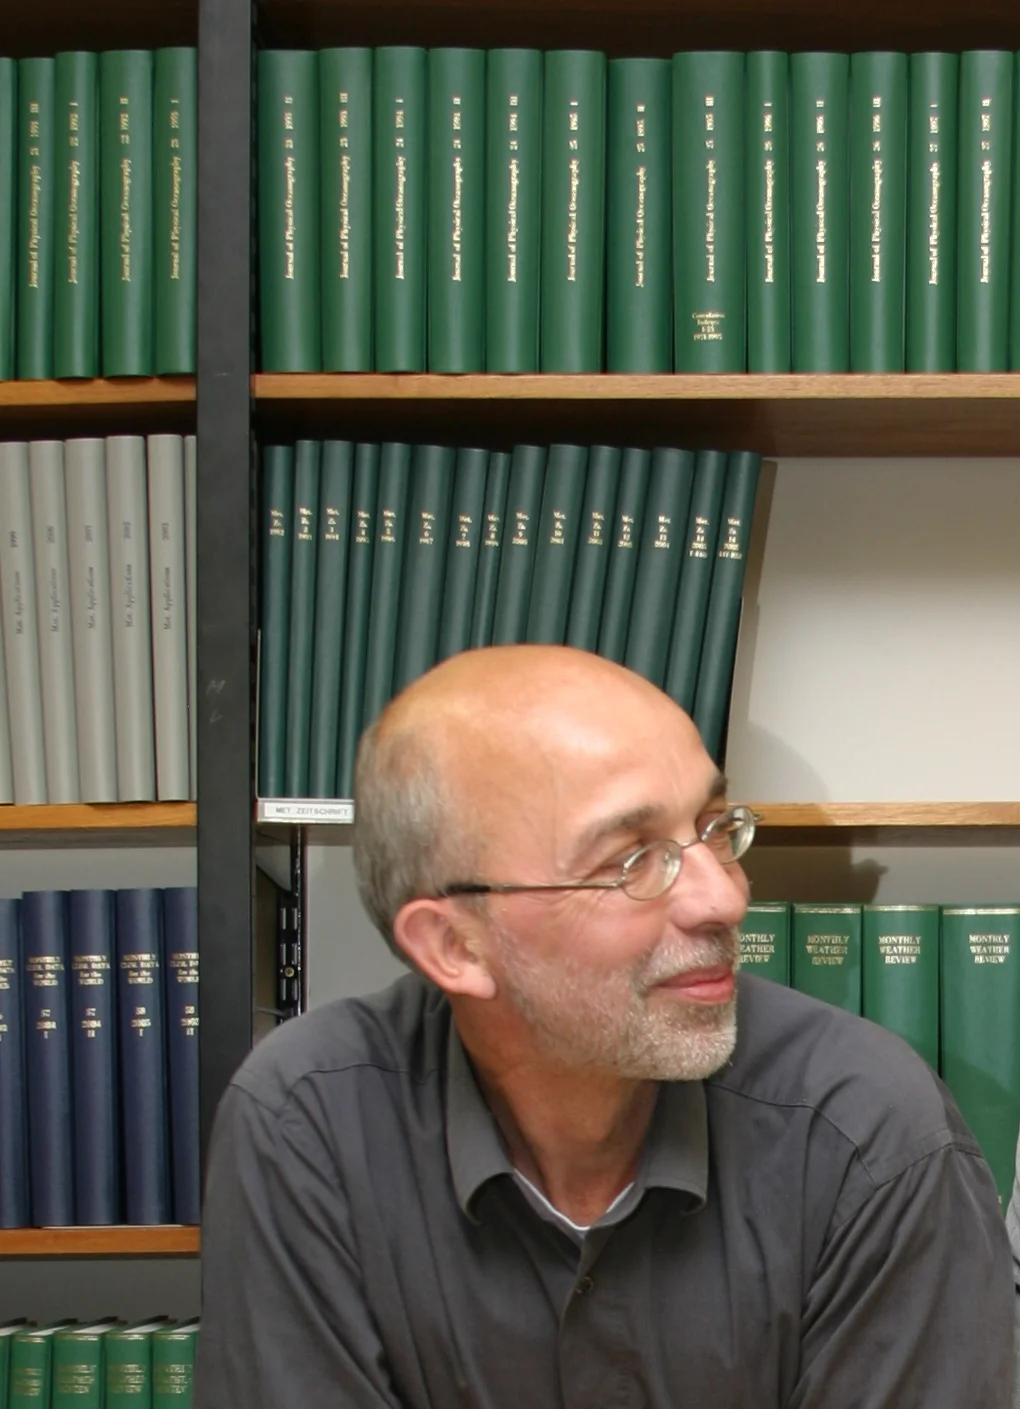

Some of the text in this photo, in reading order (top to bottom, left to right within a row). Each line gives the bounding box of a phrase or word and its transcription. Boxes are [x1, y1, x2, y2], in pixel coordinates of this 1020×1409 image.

[121, 158, 132, 210] Oceanography
[284, 156, 295, 208] Oceanography
[340, 155, 351, 207] Oceanography
[508, 159, 519, 210] Oceanography
[636, 166, 646, 218] Oceanography
[121, 213, 132, 243] Physical
[284, 209, 295, 241] Physical
[339, 208, 351, 240] Physical
[507, 211, 519, 242] Physical
[635, 219, 645, 249] Physical
[121, 254, 131, 282] Journal
[285, 252, 295, 280] Journal
[339, 251, 349, 279] Journal
[507, 254, 517, 282] Journal
[635, 261, 644, 288] Journal
[806, 945, 847, 954] WEATHER
[807, 935, 849, 944] MONTHLY
[879, 935, 921, 944] MONTHLY
[879, 945, 921, 954] WEATHER
[969, 934, 1010, 943] MONTHLY
[970, 945, 1010, 954] WEATHER
[812, 956, 844, 965] REVIEW
[885, 955, 917, 964] REVIEW
[974, 955, 1006, 964] REVIEW
